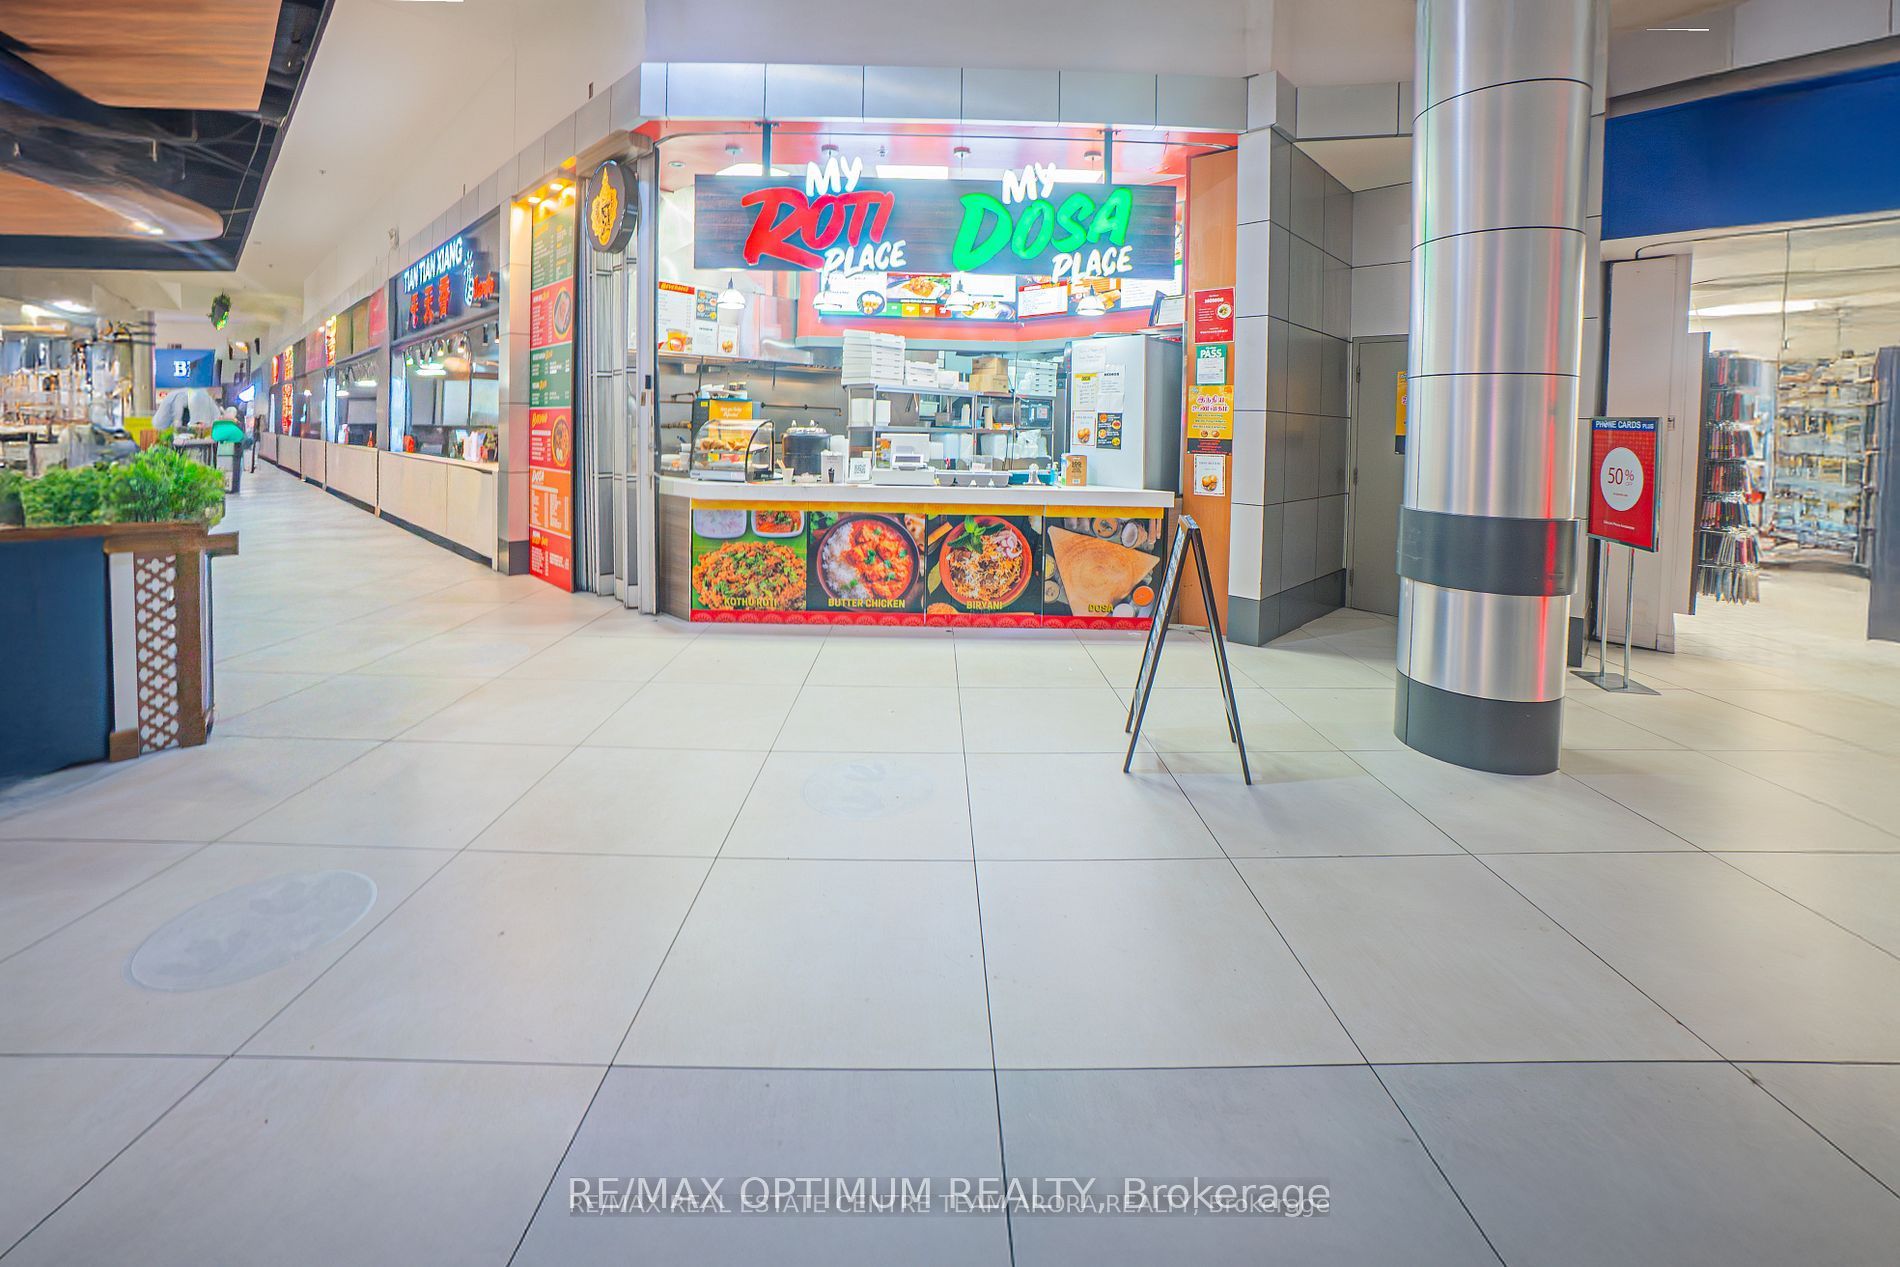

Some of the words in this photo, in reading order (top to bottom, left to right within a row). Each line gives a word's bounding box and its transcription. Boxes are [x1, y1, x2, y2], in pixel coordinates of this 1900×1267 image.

[805, 156, 864, 196] MY
[1002, 162, 1057, 204] MY
[741, 188, 896, 271] ROTI
[951, 187, 1134, 272] DOSA
[404, 264, 419, 294] TIAN
[419, 252, 436, 285] TIAN
[436, 236, 463, 275] XIANG
[823, 240, 907, 281] PLACE
[1052, 245, 1134, 282] PLACE
[1200, 349, 1222, 358] PASS
[1595, 420, 1617, 429] PHONE
[1617, 420, 1641, 430] CARDS
[1607, 467, 1635, 485] 50%
[724, 597, 755, 608] KOTHU
[756, 597, 777, 609] ROTI
[828, 598, 864, 608] BUTTER
[865, 598, 906, 609] CHICKEN
[966, 601, 1003, 610] BIRYANI
[1088, 603, 1114, 613] DOSA
